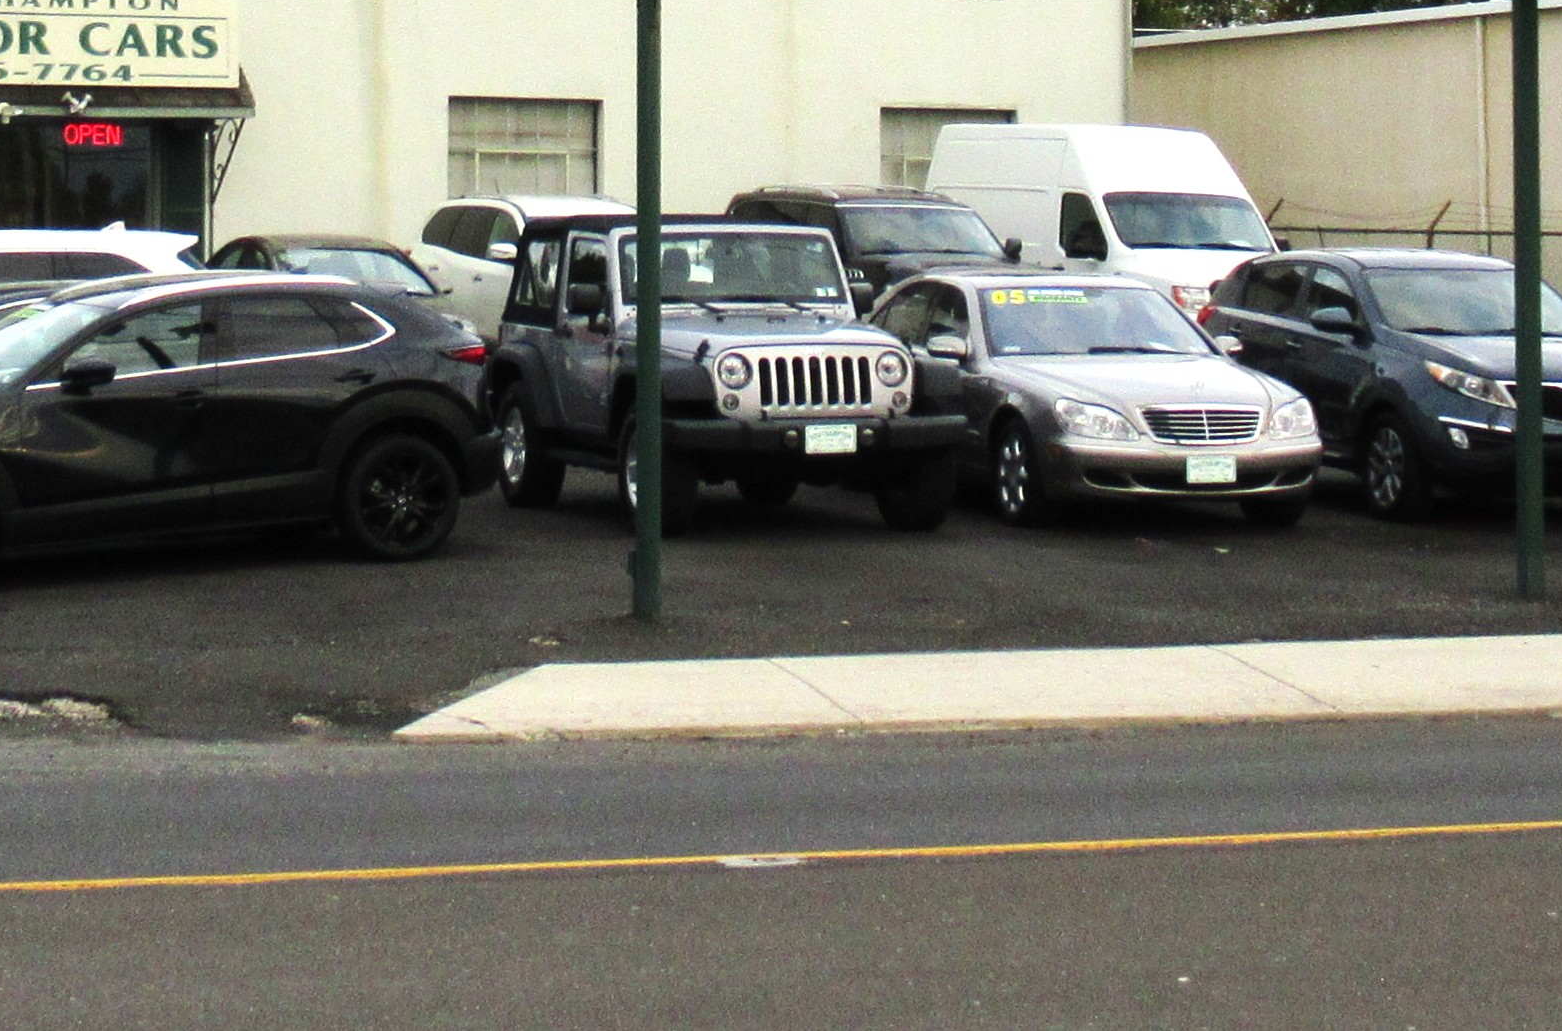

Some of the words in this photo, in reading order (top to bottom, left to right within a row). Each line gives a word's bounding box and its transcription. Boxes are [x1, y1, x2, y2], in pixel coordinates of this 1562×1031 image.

[78, 21, 219, 59] CARS
[64, 123, 122, 146] OPEN
[991, 289, 1026, 305] 05
